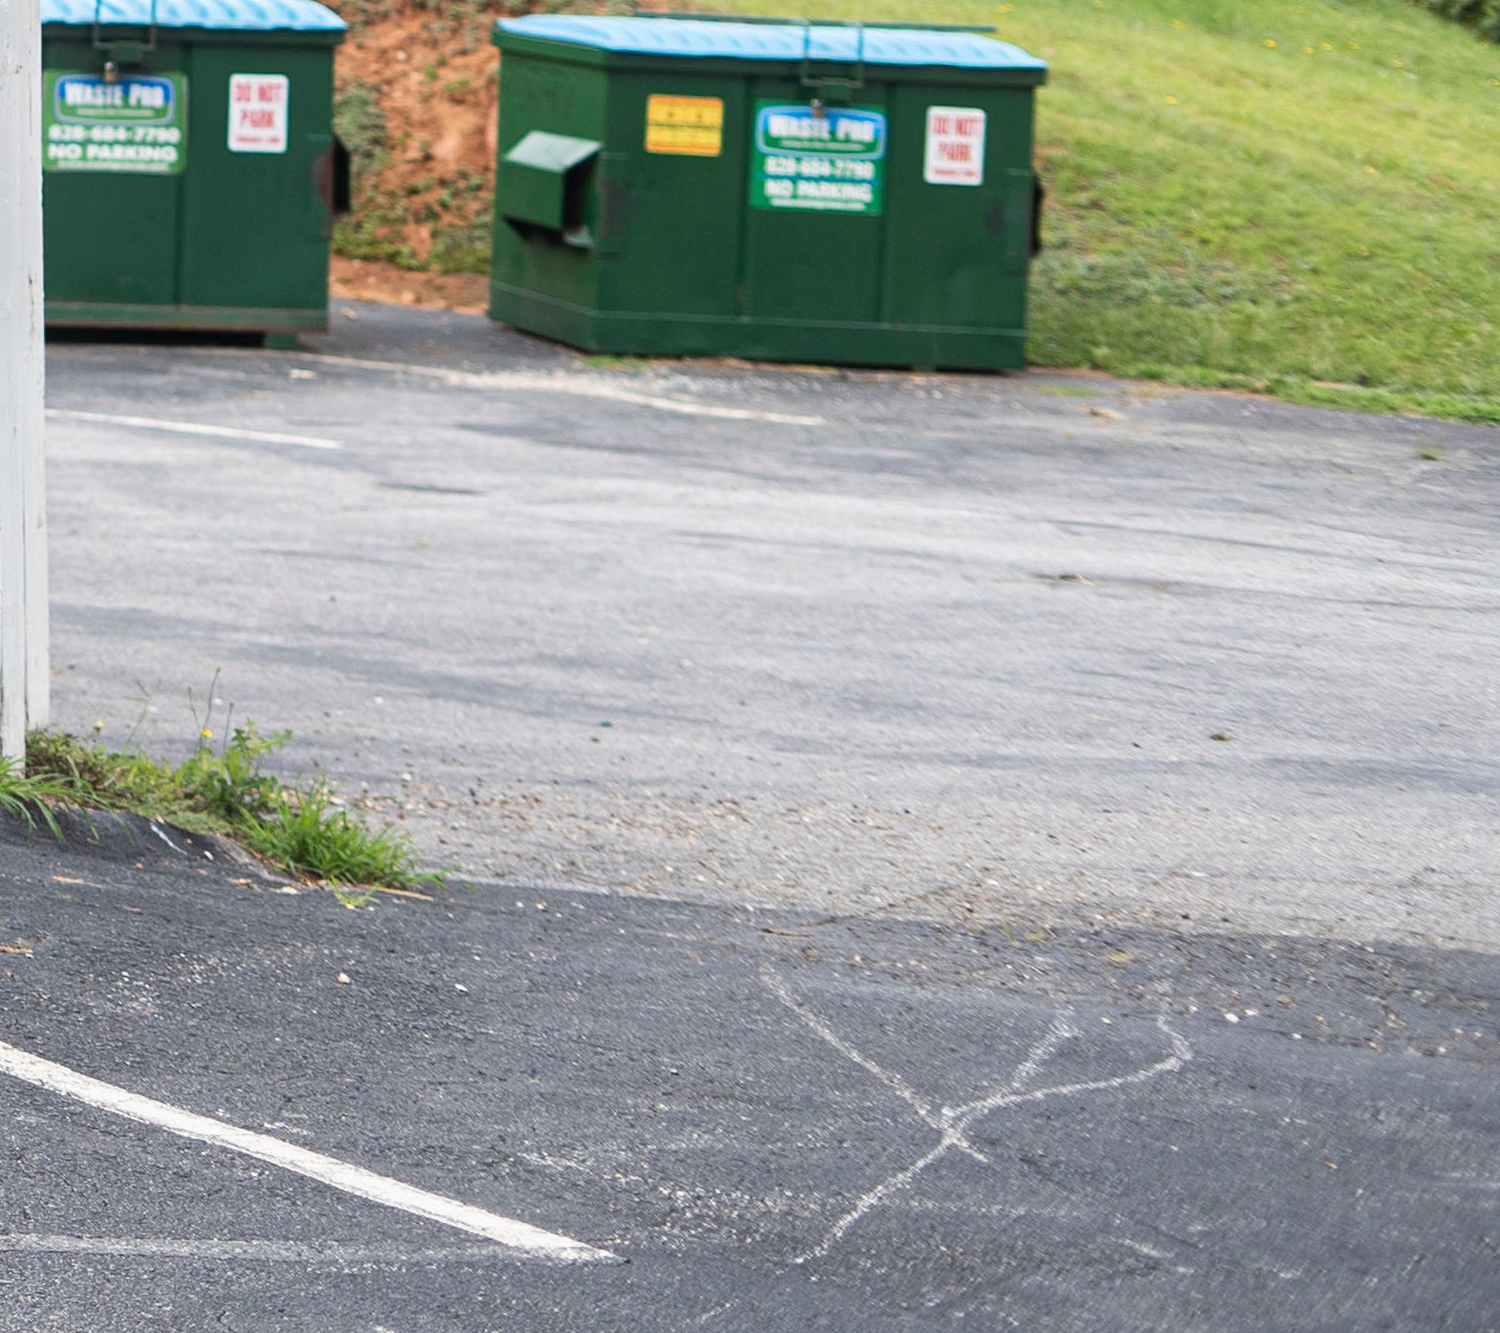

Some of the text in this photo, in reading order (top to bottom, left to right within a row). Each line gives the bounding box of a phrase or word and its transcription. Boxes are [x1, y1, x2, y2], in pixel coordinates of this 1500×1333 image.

[65, 83, 164, 108] WASTE PRO
[768, 114, 830, 140] WASTE
[48, 144, 178, 162] NO PARKING
[764, 179, 873, 203] NO PARKING
